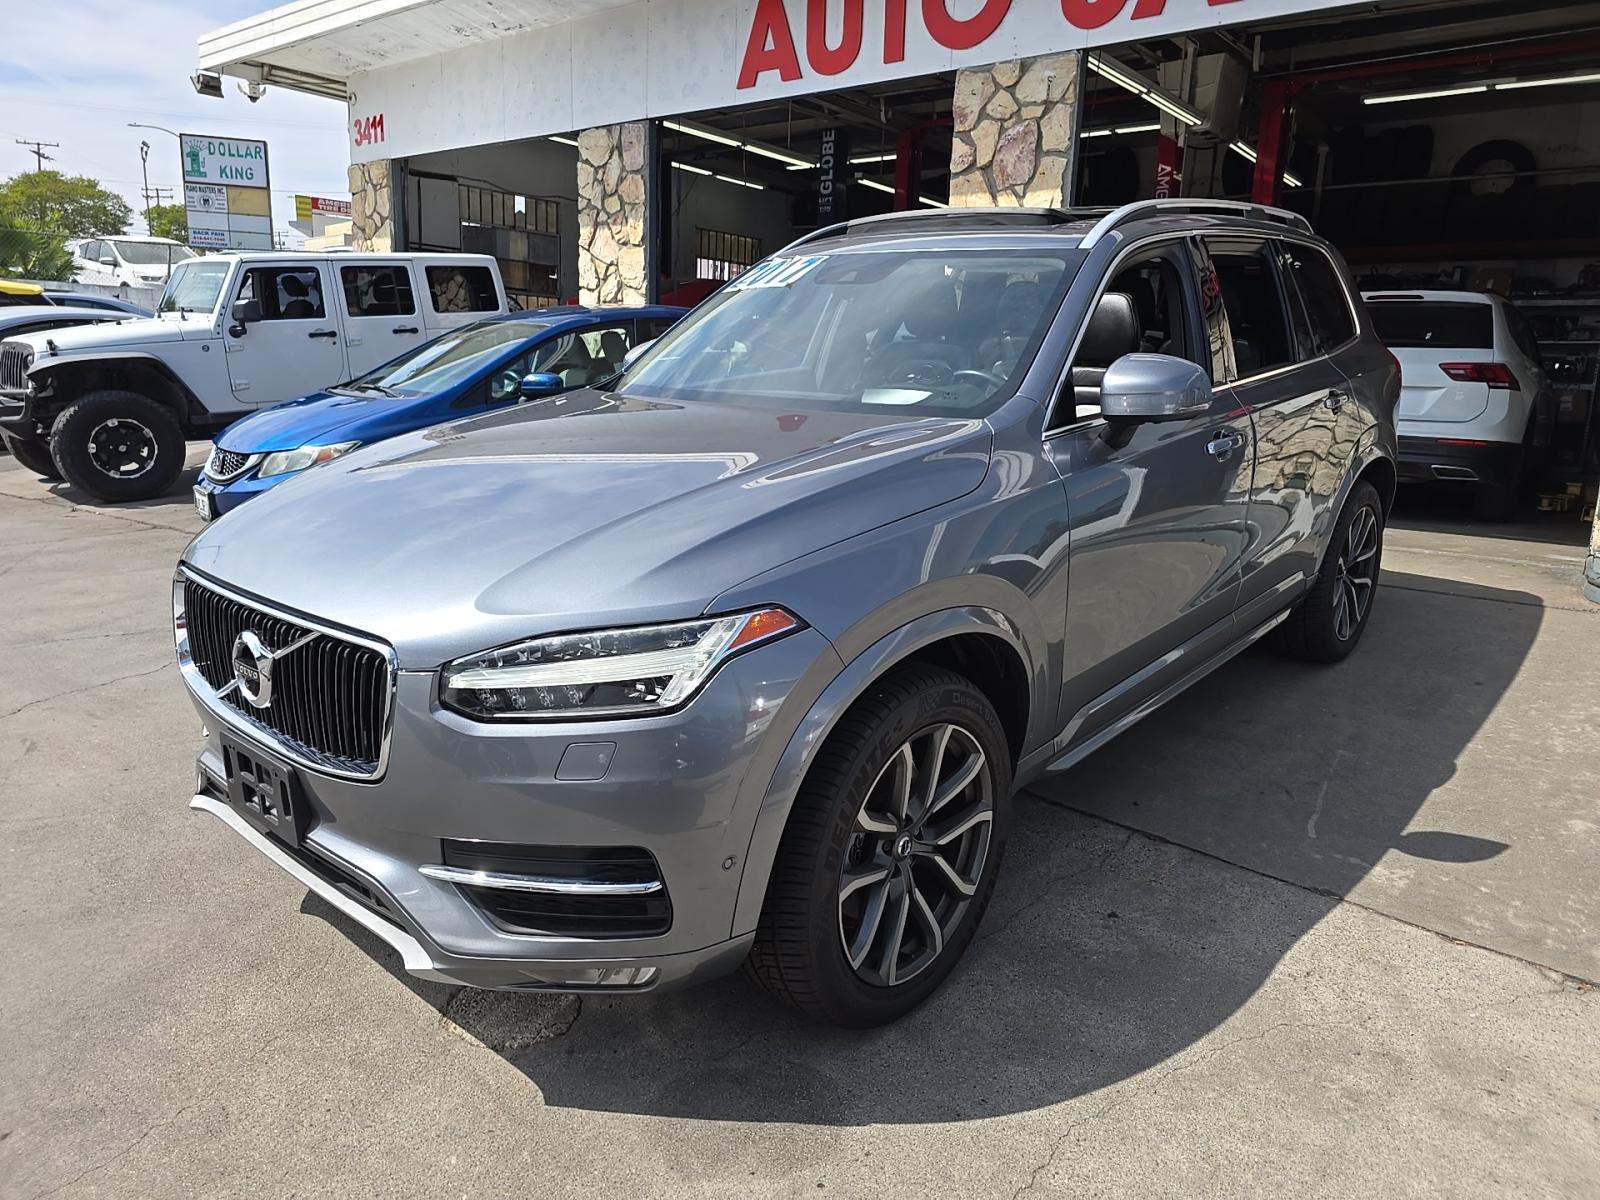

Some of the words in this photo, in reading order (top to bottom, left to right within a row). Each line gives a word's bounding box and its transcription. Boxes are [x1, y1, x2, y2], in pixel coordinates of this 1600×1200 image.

[353, 113, 385, 147] 3411
[208, 141, 263, 160] DOLLAR
[819, 129, 835, 195] GLOBE
[219, 165, 254, 181] KING
